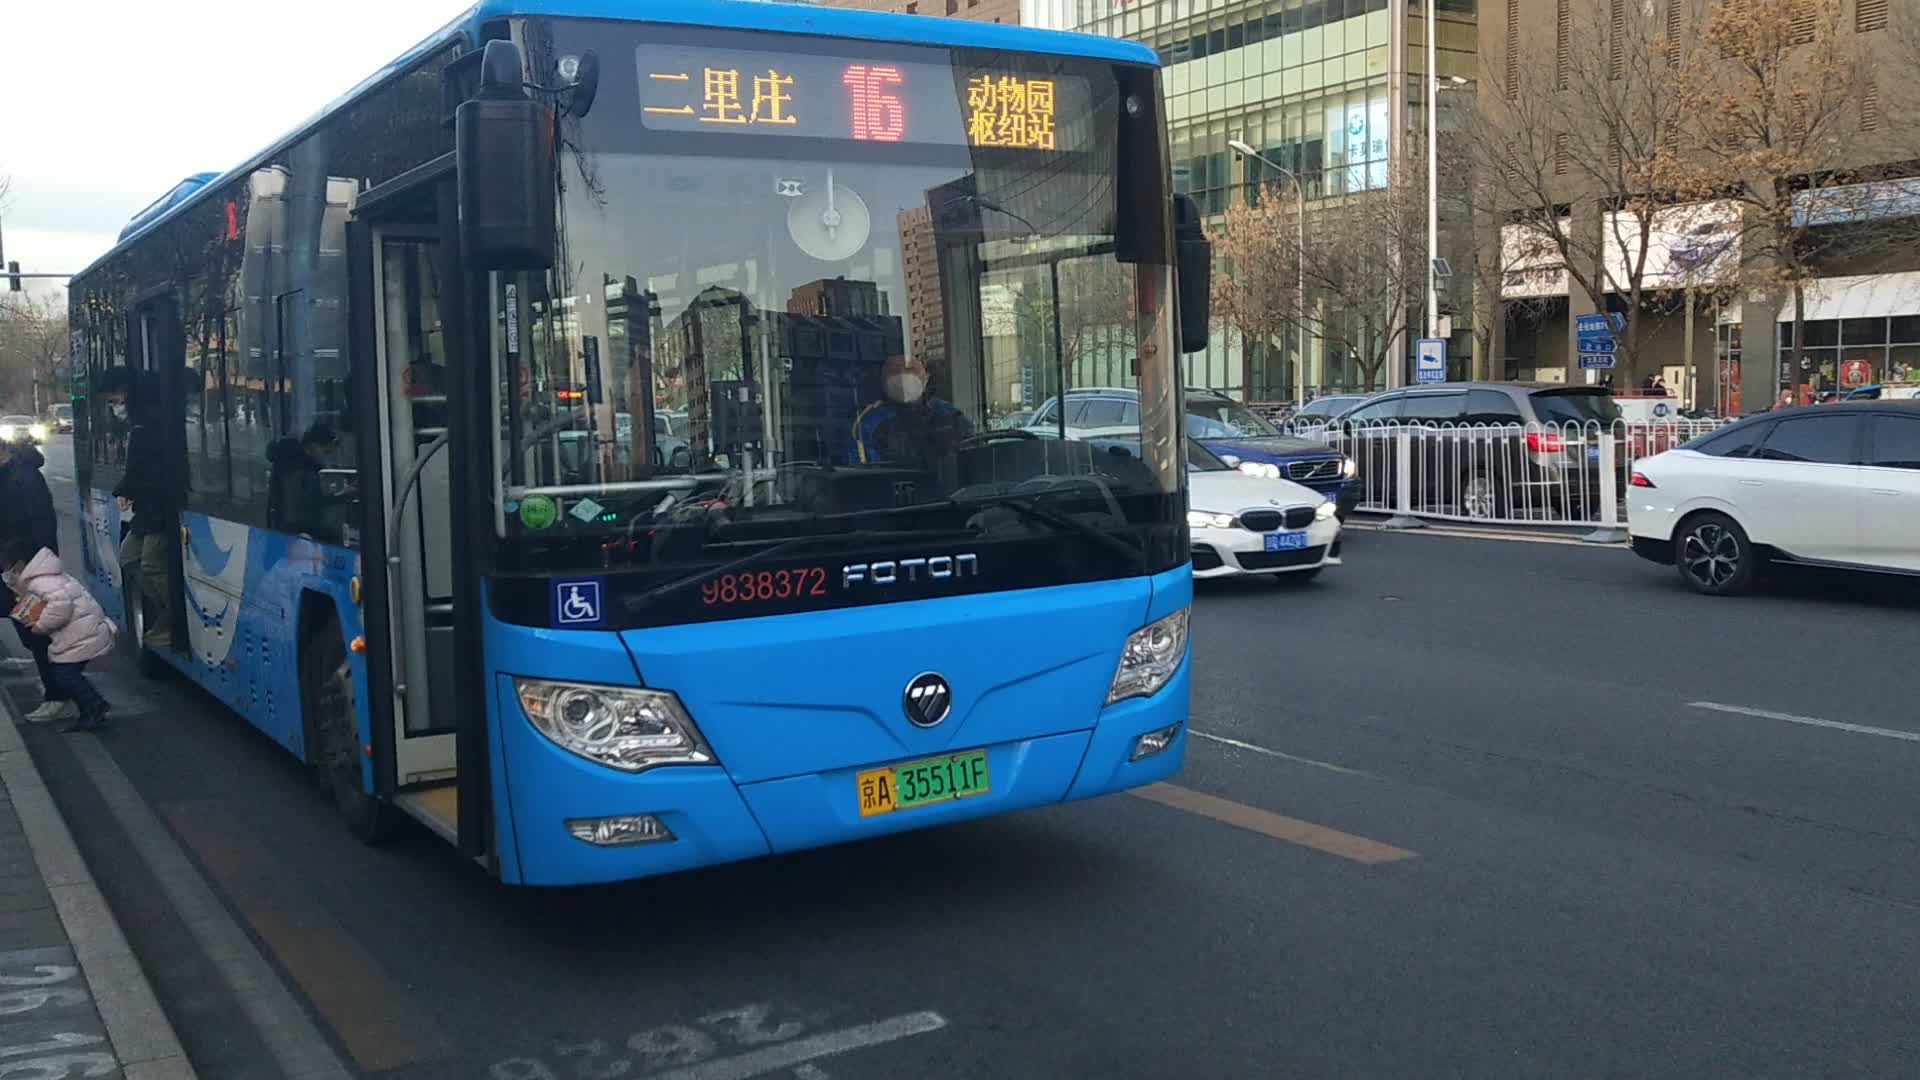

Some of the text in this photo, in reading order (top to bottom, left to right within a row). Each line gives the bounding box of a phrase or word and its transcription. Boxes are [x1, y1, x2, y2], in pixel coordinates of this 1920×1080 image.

[643, 67, 797, 125] 二里庄
[843, 65, 903, 141] 16
[967, 75, 1054, 116] 动物园
[967, 113, 1055, 150] 枢纽站
[702, 553, 978, 605] 9838372 FOTON
